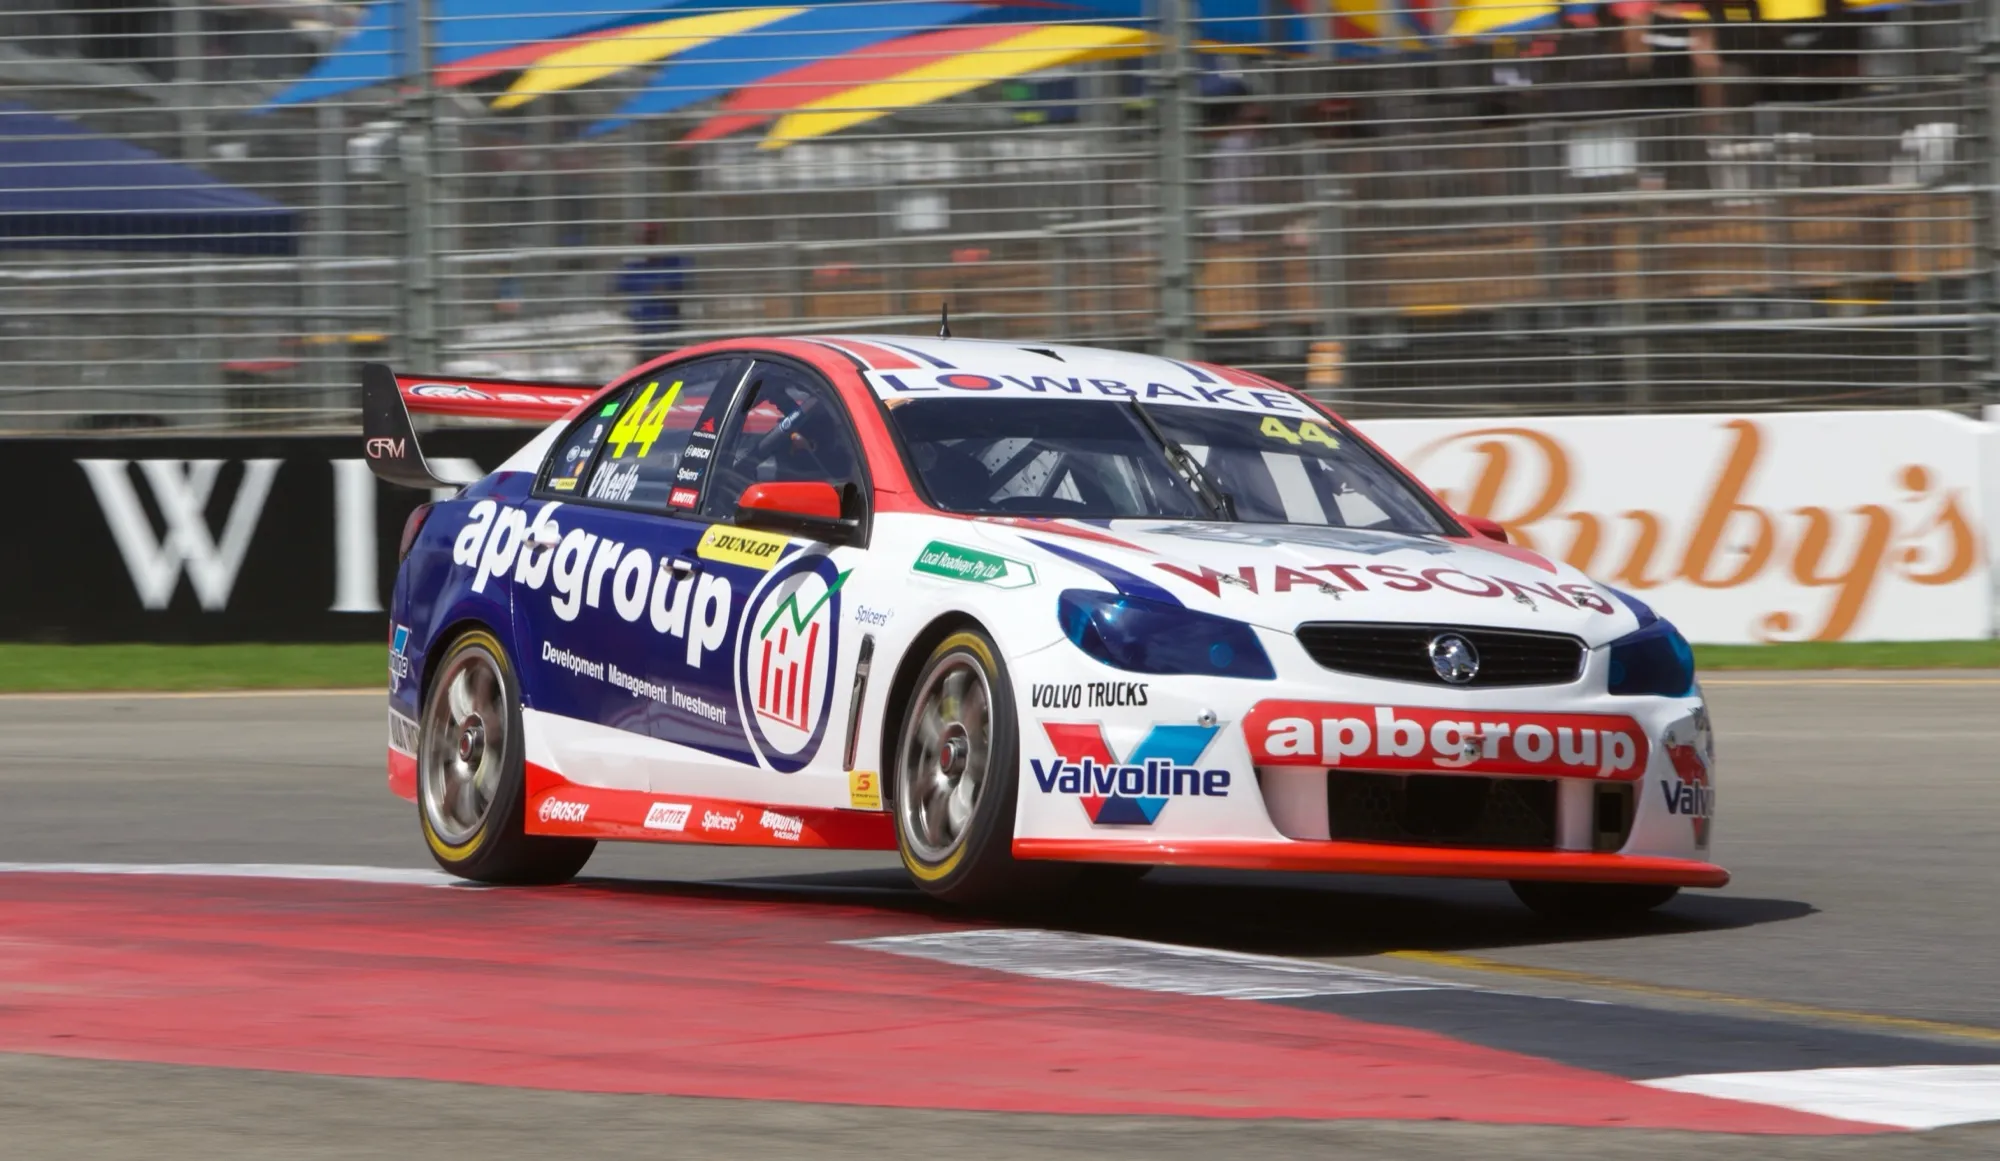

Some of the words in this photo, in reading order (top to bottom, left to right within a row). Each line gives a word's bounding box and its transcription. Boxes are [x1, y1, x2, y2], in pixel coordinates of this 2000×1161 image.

[880, 374, 1302, 412] LOWBAKE
[608, 380, 684, 459] 44
[1259, 416, 1340, 450] 44
[715, 535, 780, 558] DUNLOP
[1404, 418, 1976, 644] Ruby's
[920, 548, 944, 566] Local
[453, 500, 732, 668] apbgroup
[1152, 562, 1615, 616] WATSONS
[854, 605, 888, 627] Spicers
[542, 640, 604, 681] Development
[608, 664, 667, 705] Management
[671, 690, 727, 726] Investment
[1032, 683, 1082, 709] VOLVO
[1087, 682, 1149, 707] TRUCKS
[1264, 707, 1638, 778] apbgroup
[1030, 757, 1232, 797] Valvoline
[550, 801, 590, 823] BOSCH
[650, 807, 687, 827] LOCTITE
[702, 810, 737, 833] Spicers
